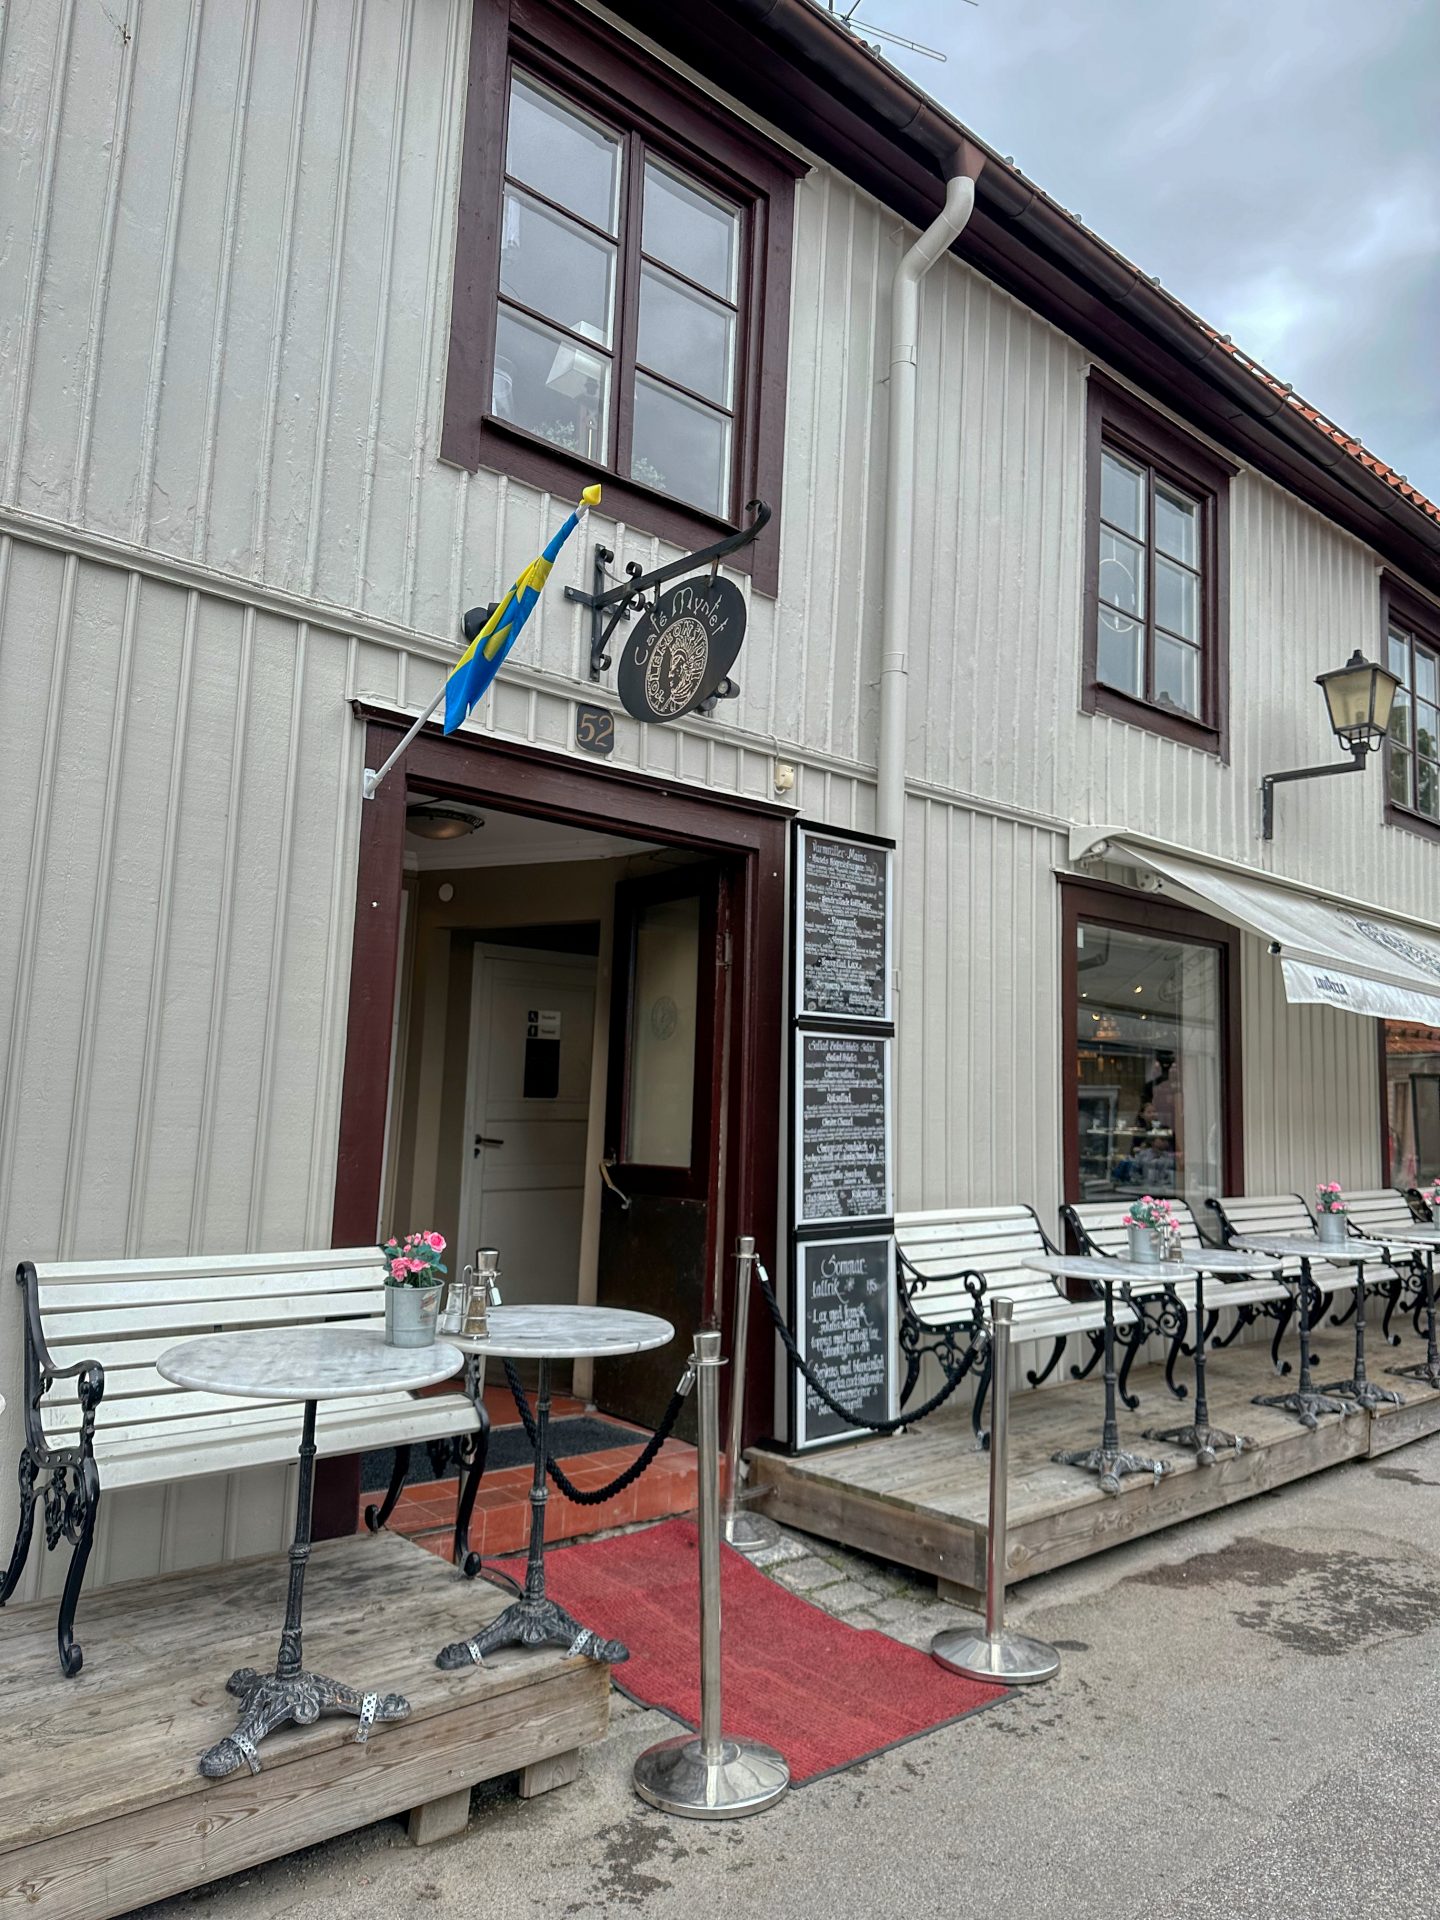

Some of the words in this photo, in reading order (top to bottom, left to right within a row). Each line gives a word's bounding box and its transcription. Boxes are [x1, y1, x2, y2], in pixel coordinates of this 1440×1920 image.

[634, 611, 668, 666] Café
[672, 586, 729, 636] Myntet
[578, 714, 613, 747] 52
[847, 848, 867, 863] Mains
[812, 1309, 827, 1323] Lax
[829, 1304, 843, 1321] med
[833, 1331, 846, 1344] med
[840, 1360, 852, 1375] med
